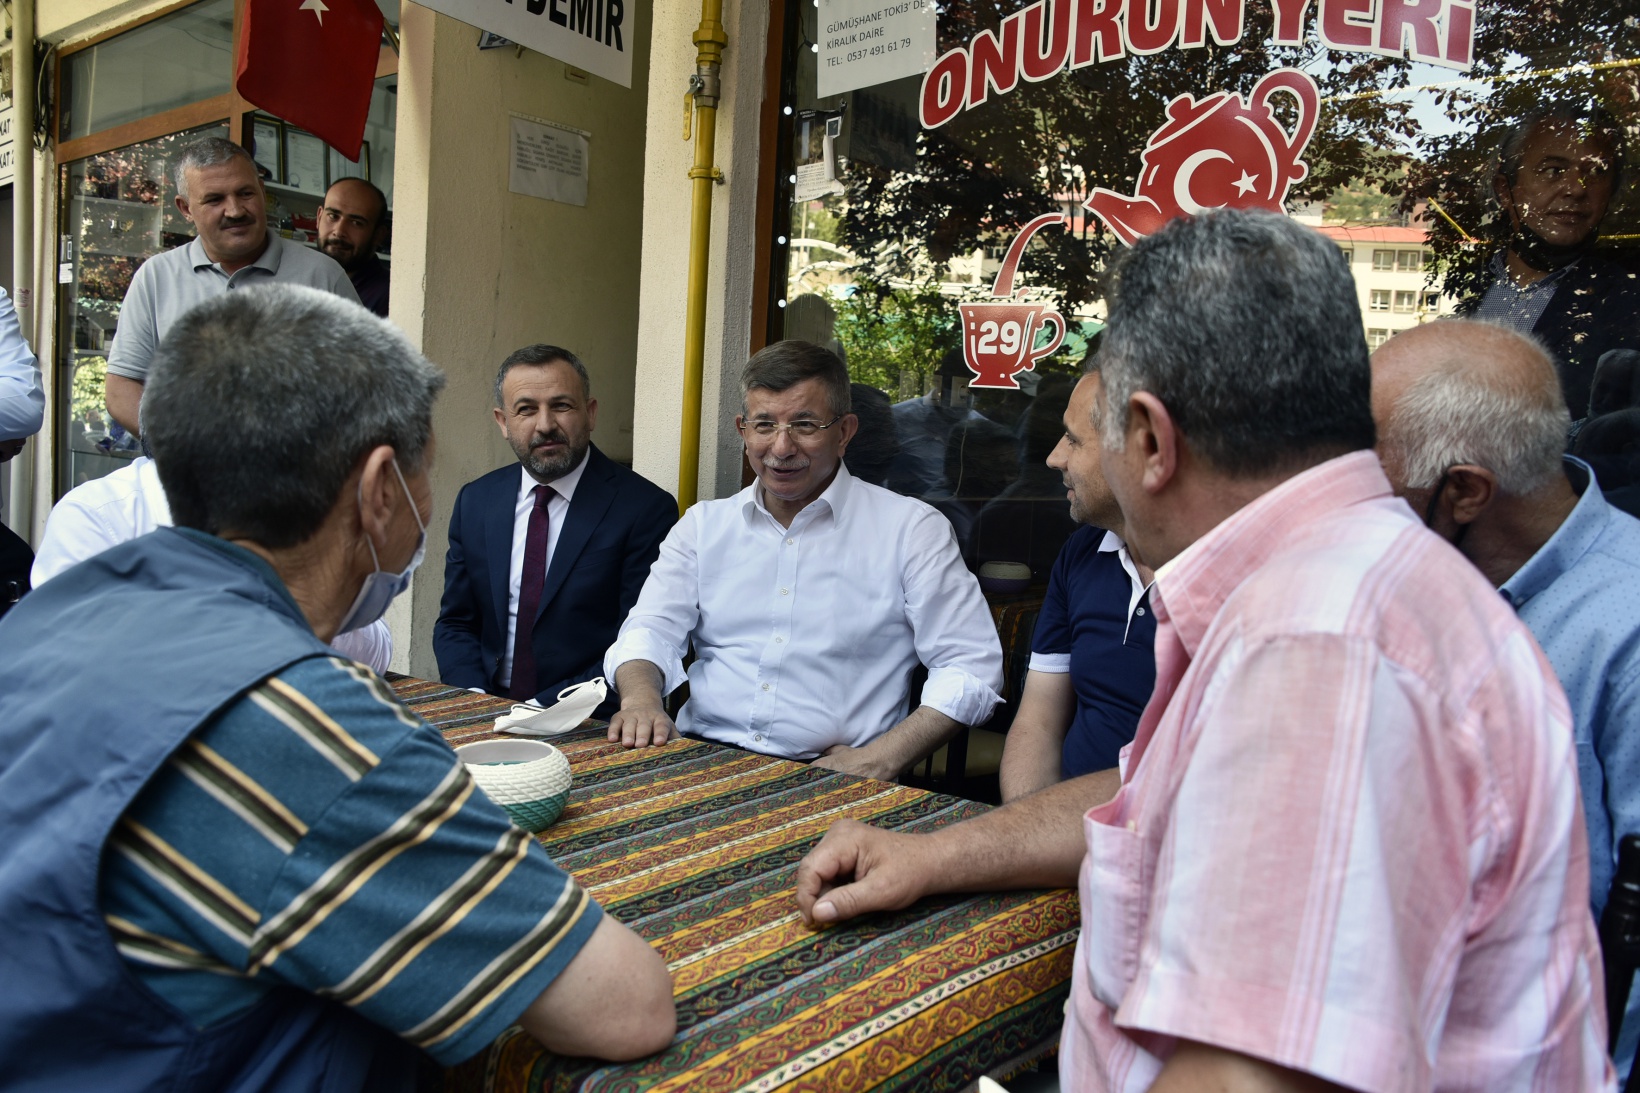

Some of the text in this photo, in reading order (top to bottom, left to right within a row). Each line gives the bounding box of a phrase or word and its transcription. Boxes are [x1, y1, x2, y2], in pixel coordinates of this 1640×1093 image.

[826, 10, 882, 34] GÜMÜŞHANE
[913, 0, 925, 10] DE
[826, 26, 885, 50] KİRALIK DAİRE
[826, 37, 911, 67] TEL: 0537 491 61 79
[919, 0, 1244, 129] ONURUN
[978, 320, 1022, 356] 29
